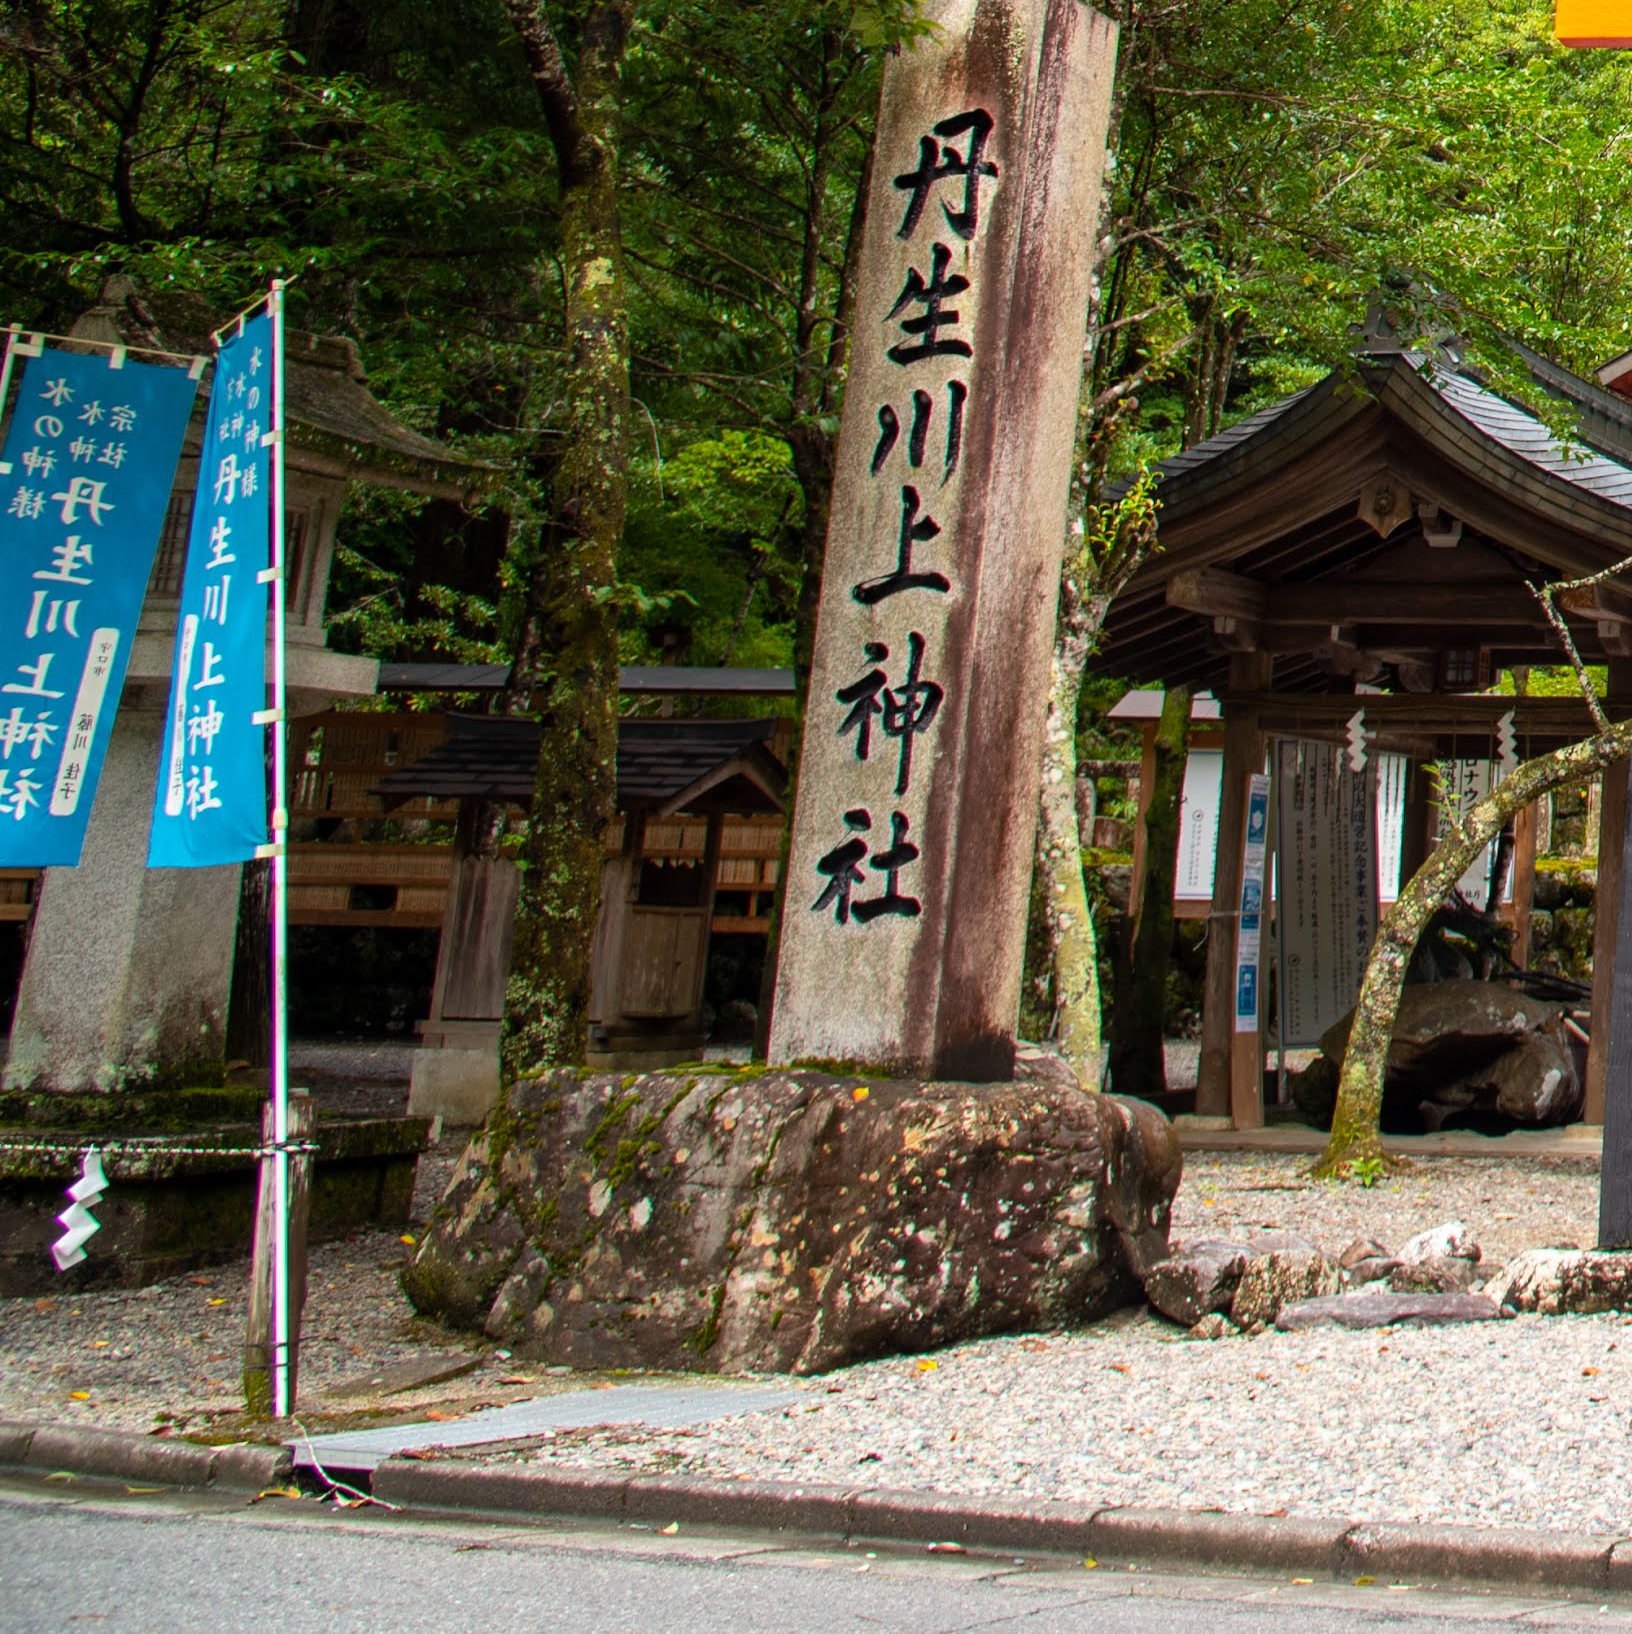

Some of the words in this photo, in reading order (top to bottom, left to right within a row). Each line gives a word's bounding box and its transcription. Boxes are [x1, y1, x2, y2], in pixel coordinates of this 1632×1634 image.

[241, 346, 263, 499] 水の神様
[812, 108, 1000, 925] 丹生川上神社
[185, 453, 242, 822] 丹生川上神社
